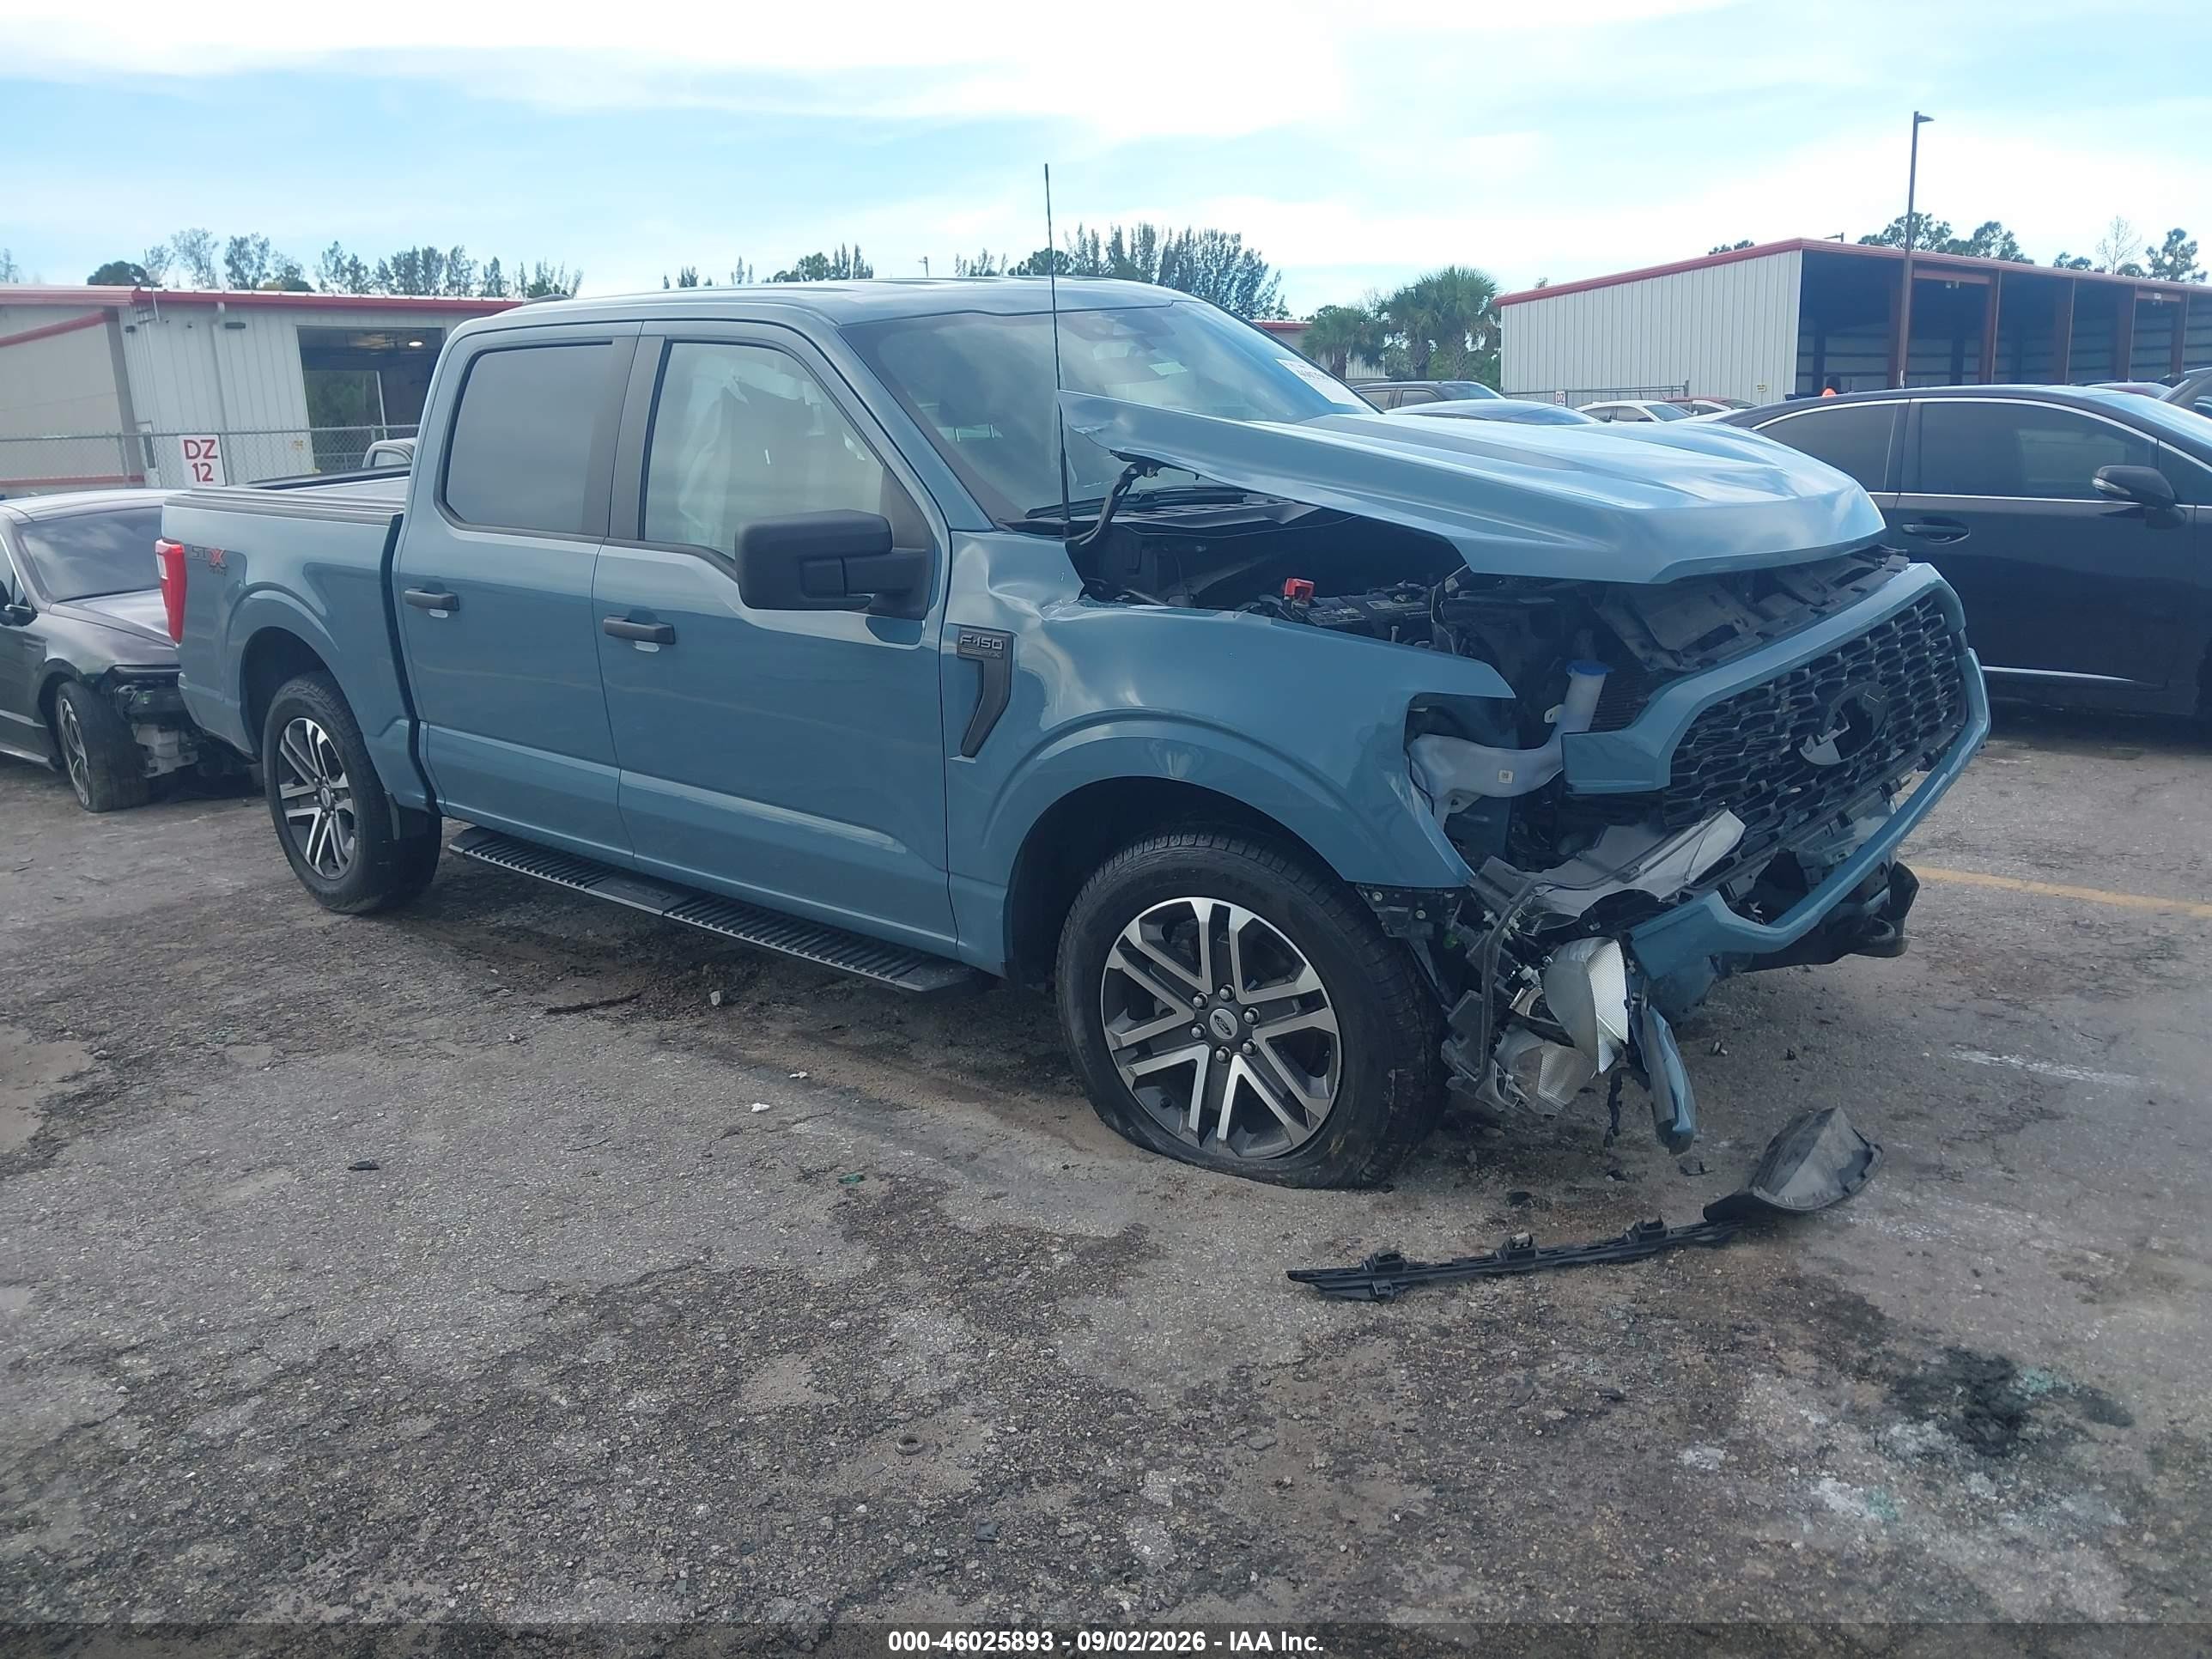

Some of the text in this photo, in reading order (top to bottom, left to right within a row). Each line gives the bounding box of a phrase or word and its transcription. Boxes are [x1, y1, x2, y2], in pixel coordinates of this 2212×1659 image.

[183, 439, 218, 460] DZ
[191, 462, 214, 483] 12
[960, 635, 1003, 650] F-150
